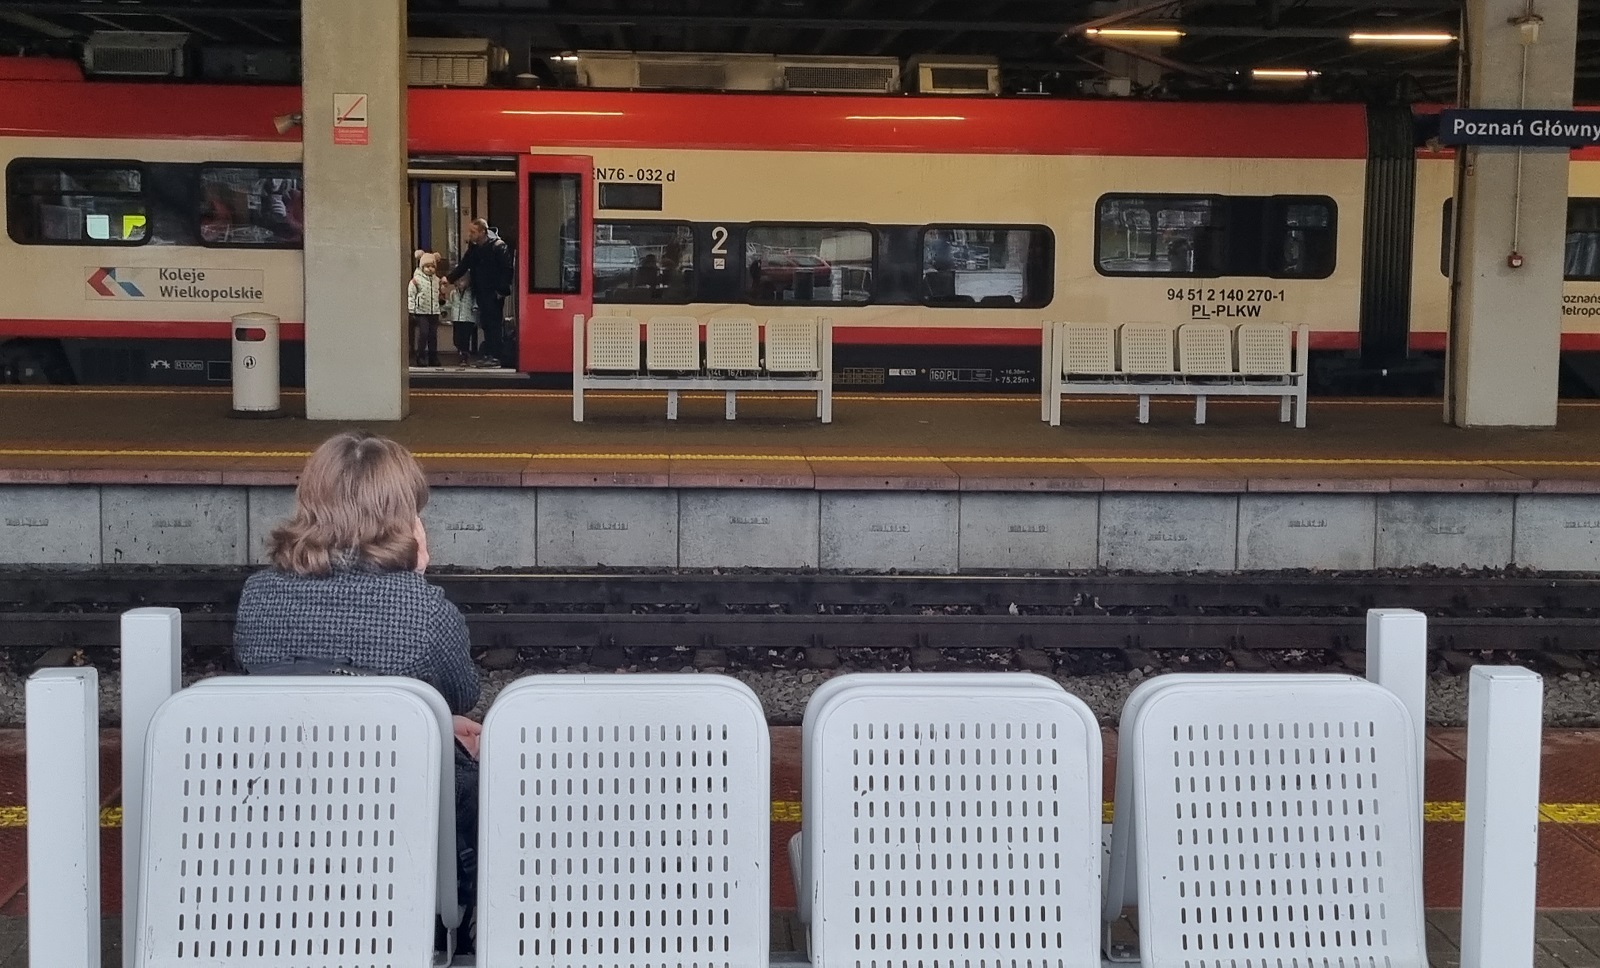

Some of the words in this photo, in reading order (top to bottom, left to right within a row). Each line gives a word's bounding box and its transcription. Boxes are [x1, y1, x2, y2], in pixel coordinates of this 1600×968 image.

[1453, 118, 1524, 136] Poznań
[1529, 119, 1600, 141] Główny
[636, 168, 663, 181] 032
[666, 170, 676, 181] d
[711, 226, 728, 254] 2
[159, 268, 205, 283] Koleje
[159, 286, 263, 302] Wielkopolskie
[1167, 288, 1184, 300] 94
[1187, 289, 1203, 301] 51
[1207, 289, 1216, 301] 2
[1219, 289, 1244, 301] 140
[1247, 290, 1285, 302] 270-1
[1191, 304, 1262, 319] PL-PLKW
[931, 370, 945, 381] 160
[946, 371, 958, 381] PL
[1001, 376, 1030, 384] 75,25m
